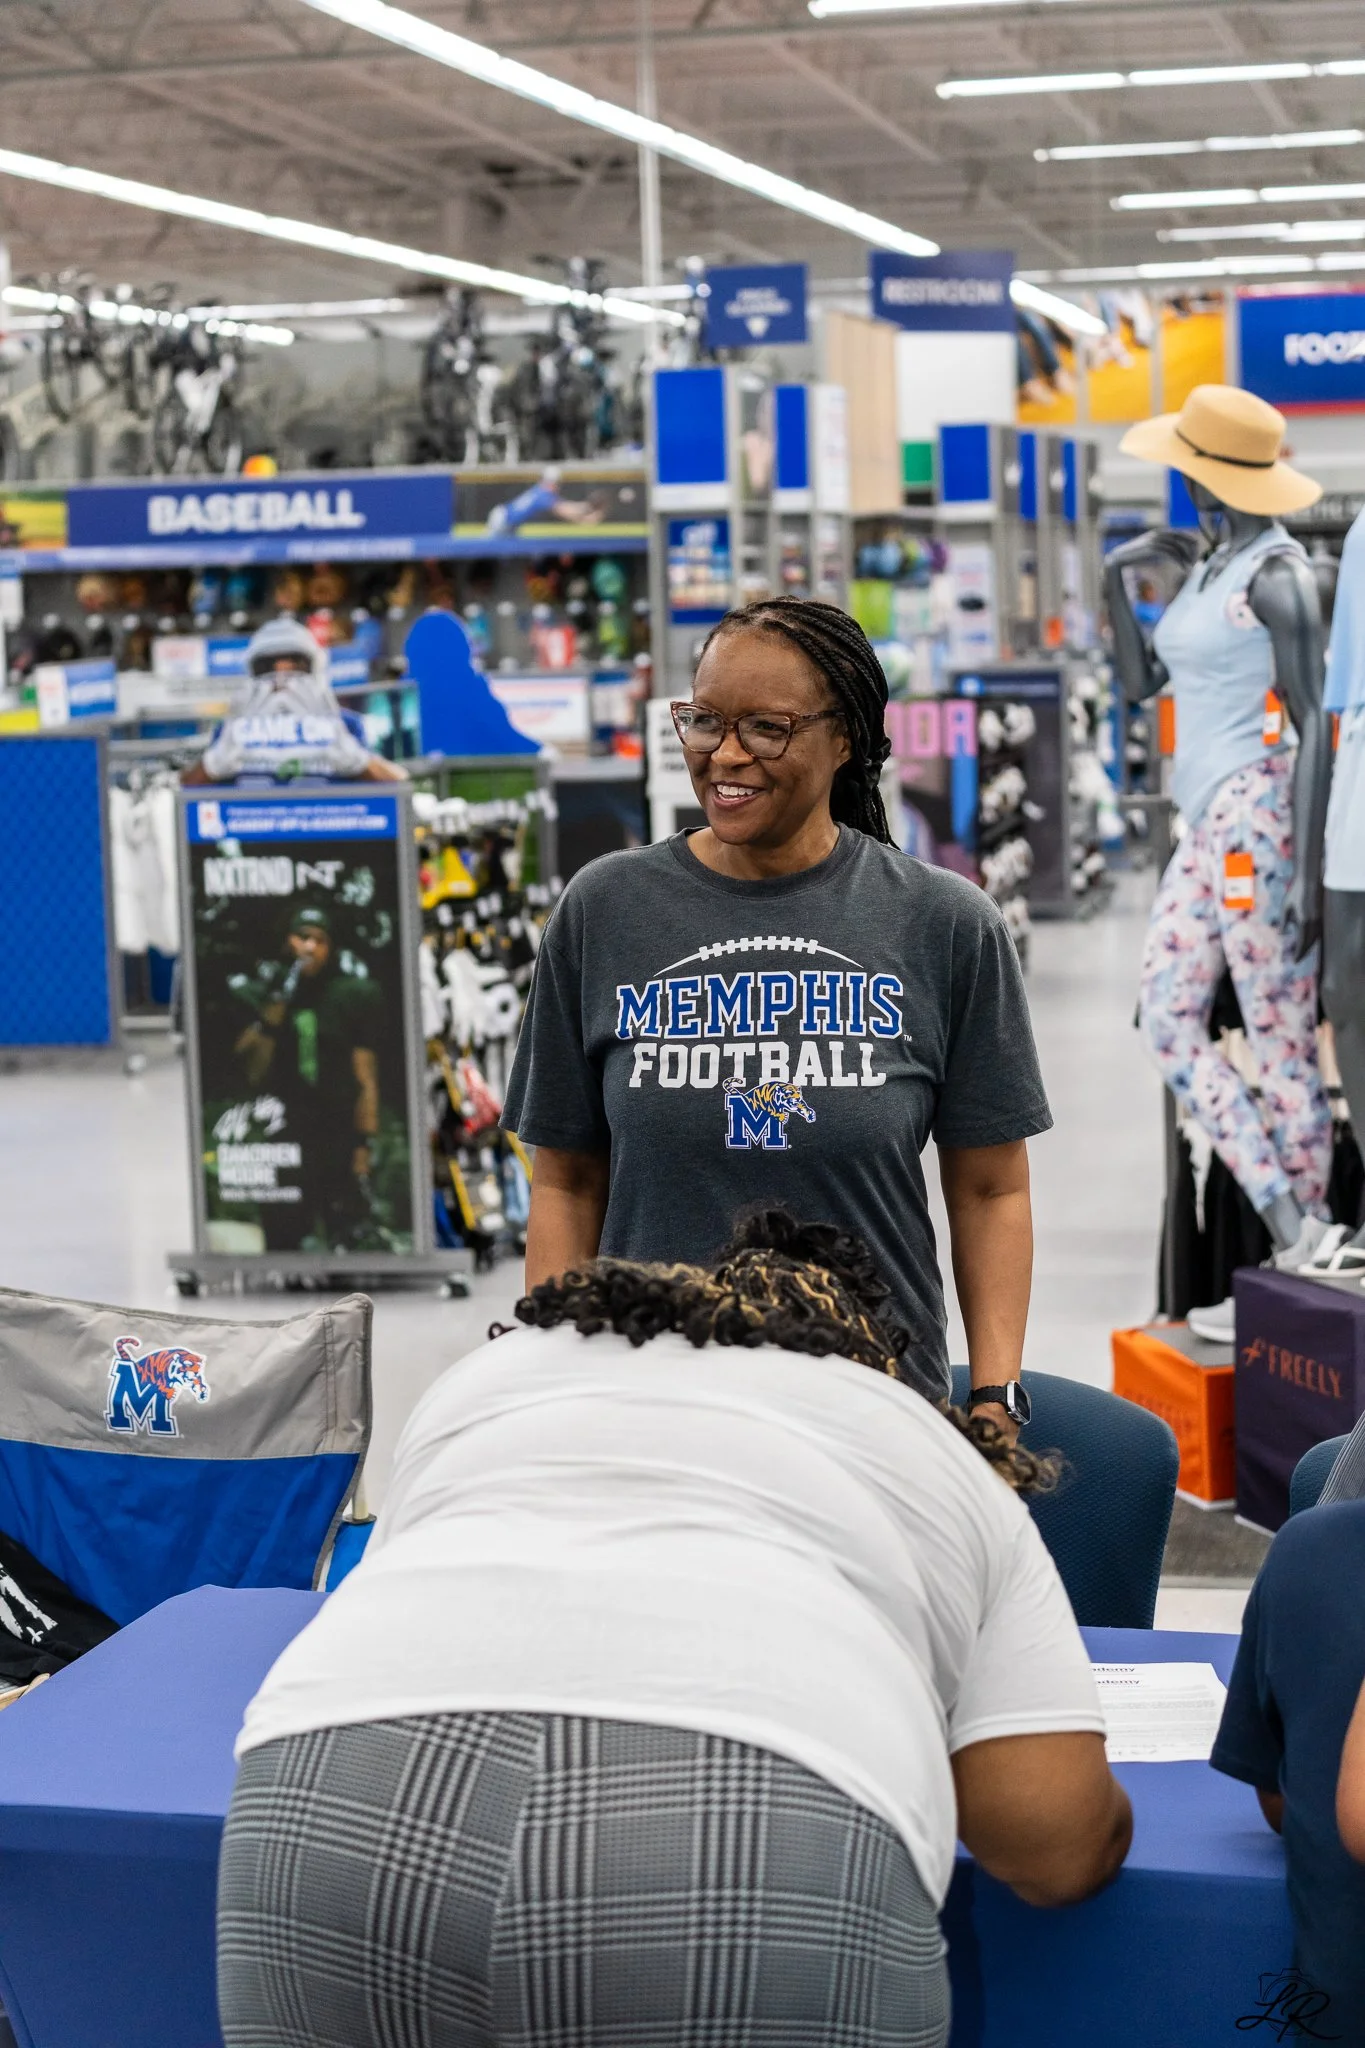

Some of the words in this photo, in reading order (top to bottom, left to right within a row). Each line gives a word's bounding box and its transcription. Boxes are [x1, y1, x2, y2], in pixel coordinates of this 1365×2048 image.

[149, 489, 365, 535] BASEBALL
[615, 970, 904, 1040] MEMPHIS
[628, 1040, 887, 1088] FOOTBALL
[1267, 1345, 1343, 1399] FREELY
